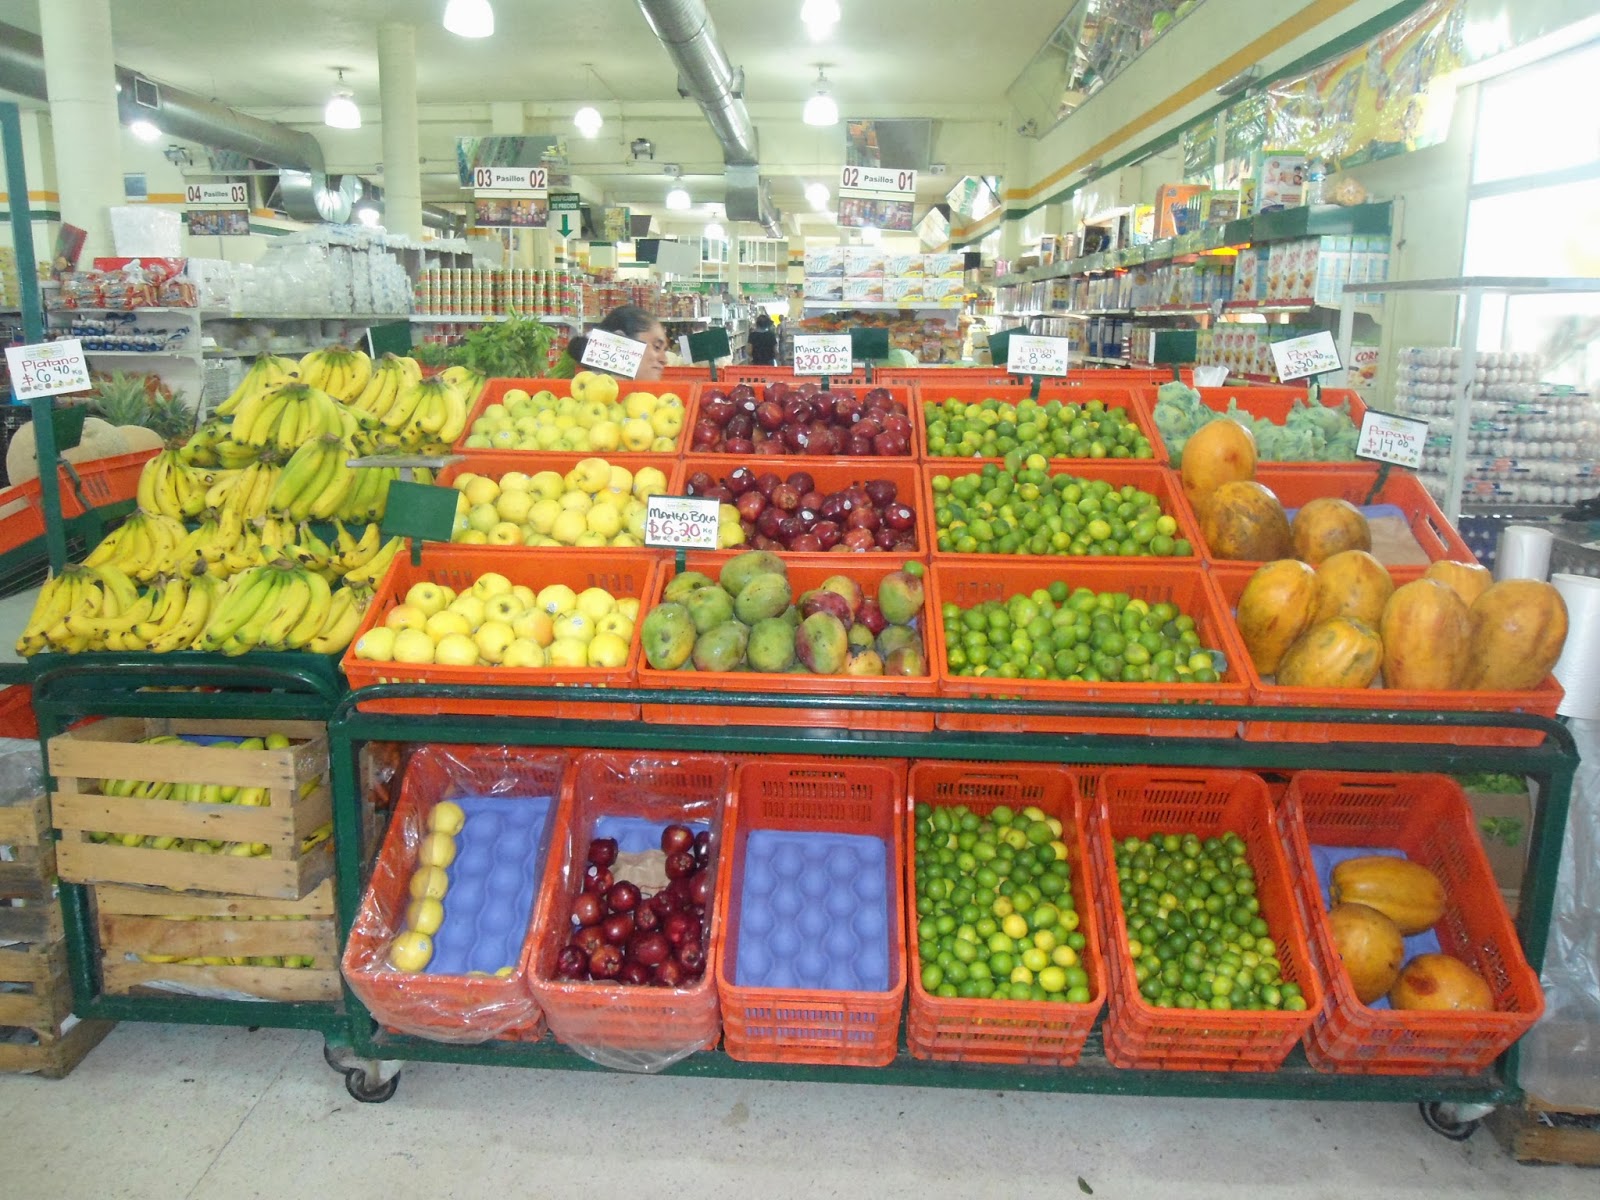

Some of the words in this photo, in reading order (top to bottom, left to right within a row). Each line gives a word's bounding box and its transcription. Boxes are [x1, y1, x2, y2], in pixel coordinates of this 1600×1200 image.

[477, 169, 492, 187] 03
[529, 170, 545, 188] 02
[843, 168, 859, 187] 02
[864, 175, 894, 184] Pasillos
[898, 172, 914, 190] 01
[188, 186, 201, 202] 04
[232, 186, 245, 202] 03
[22, 356, 80, 372] Platano
[1369, 424, 1415, 442] Papaya
[650, 507, 689, 522] MANGO
